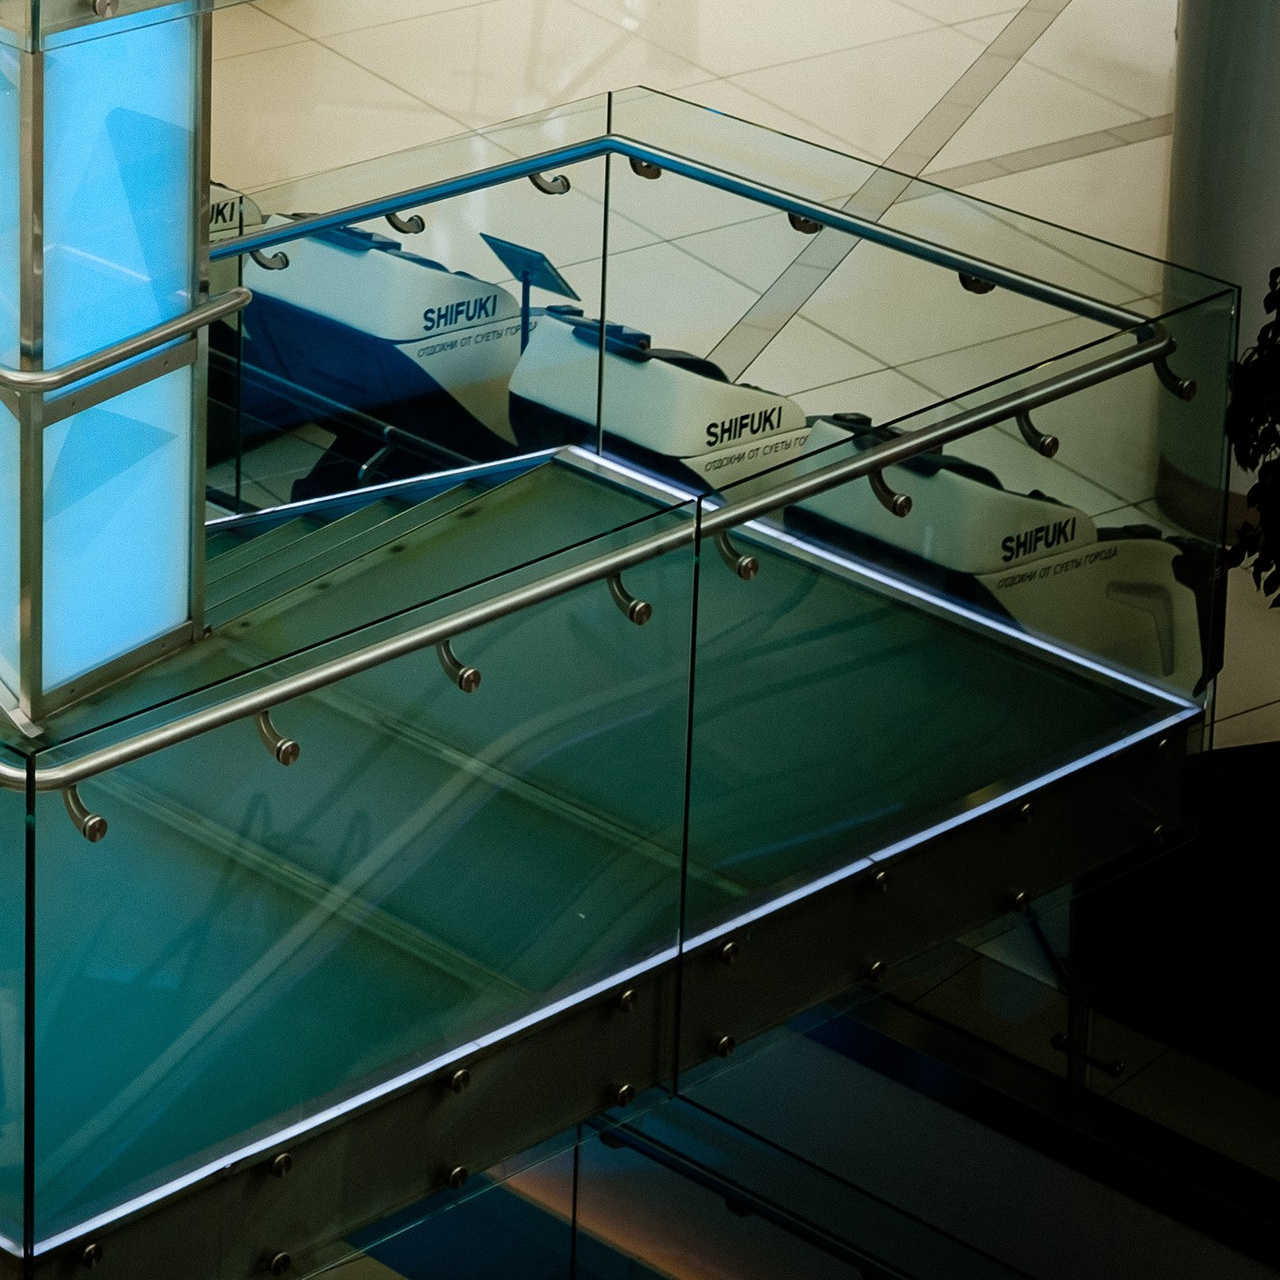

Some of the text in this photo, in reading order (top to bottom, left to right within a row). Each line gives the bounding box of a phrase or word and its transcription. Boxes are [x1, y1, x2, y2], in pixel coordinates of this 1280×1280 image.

[423, 295, 497, 331] SHIFUKI
[460, 335, 472, 347] ОТ
[706, 406, 782, 447] SHIFUKI
[747, 447, 760, 460] ОТ
[762, 440, 792, 456] СУЕТЫ
[1001, 517, 1076, 562] SHIFUKI
[1038, 566, 1051, 579] ОТ
